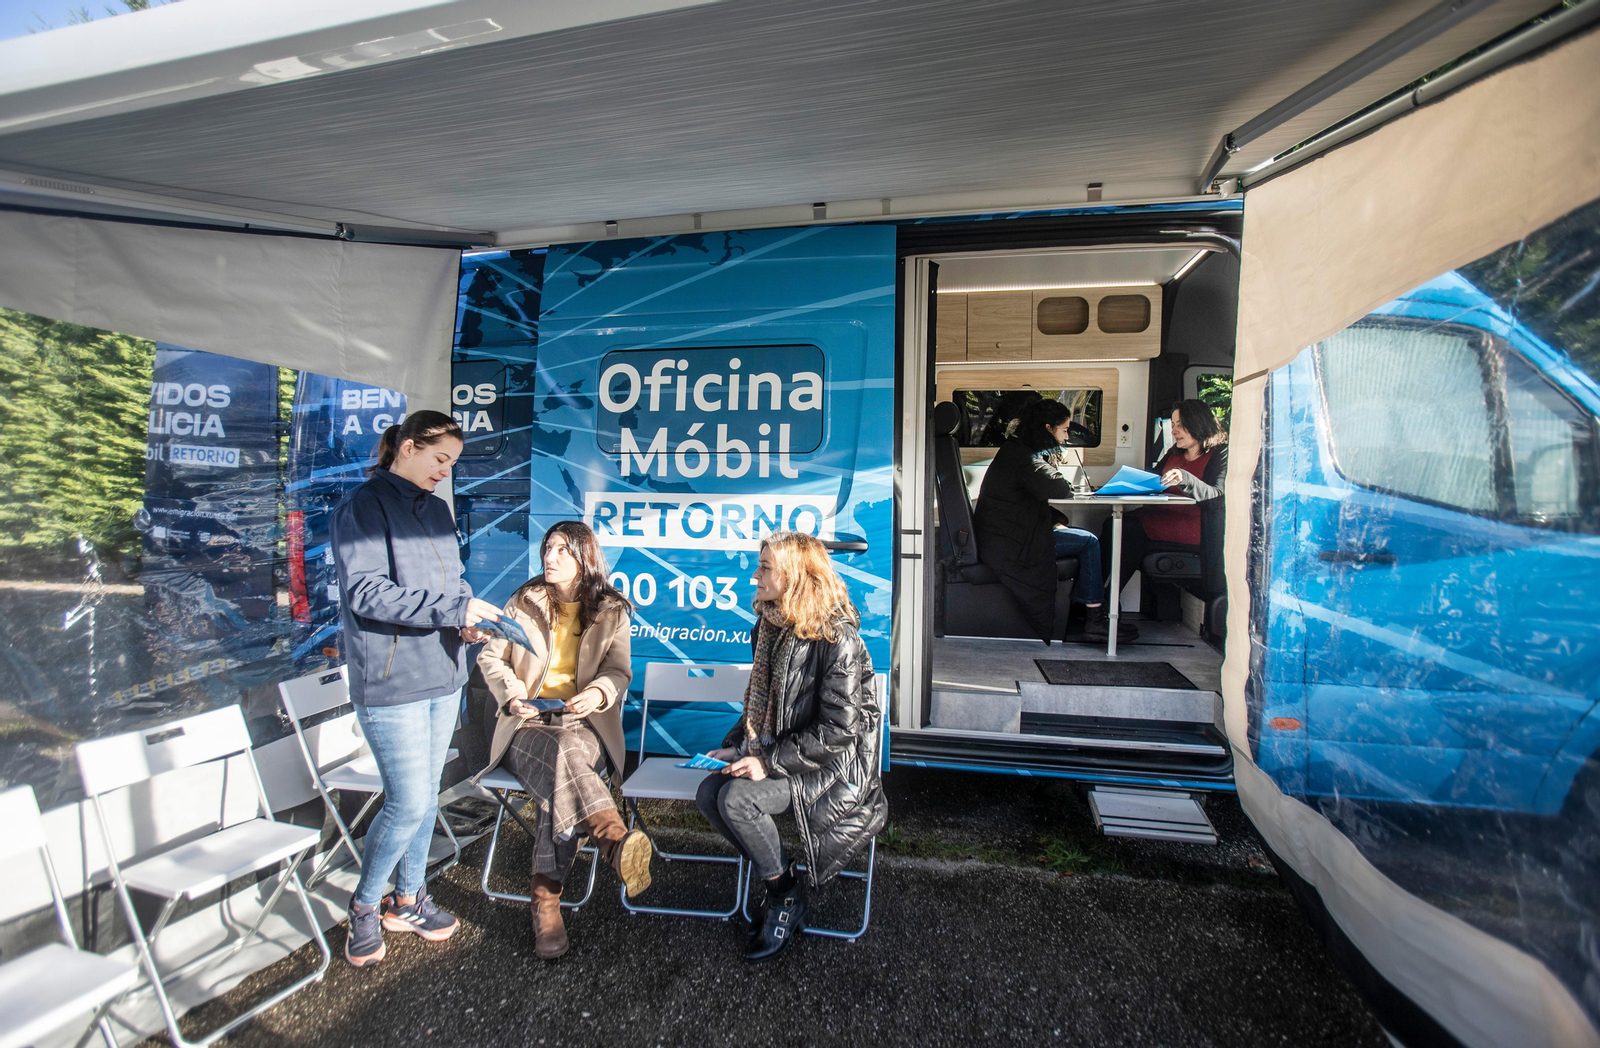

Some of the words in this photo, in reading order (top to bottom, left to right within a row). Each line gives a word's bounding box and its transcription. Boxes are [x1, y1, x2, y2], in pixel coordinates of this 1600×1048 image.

[599, 357, 823, 413] Oficina
[342, 388, 407, 410] BEN
[149, 411, 226, 438] LICIA
[342, 414, 363, 435] A
[372, 413, 406, 435] G
[173, 447, 236, 464] RETORNO
[620, 423, 799, 479] Móbil
[592, 501, 823, 540] RETORNO
[668, 575, 738, 610] 103
[630, 622, 751, 644] emigracion.xu
